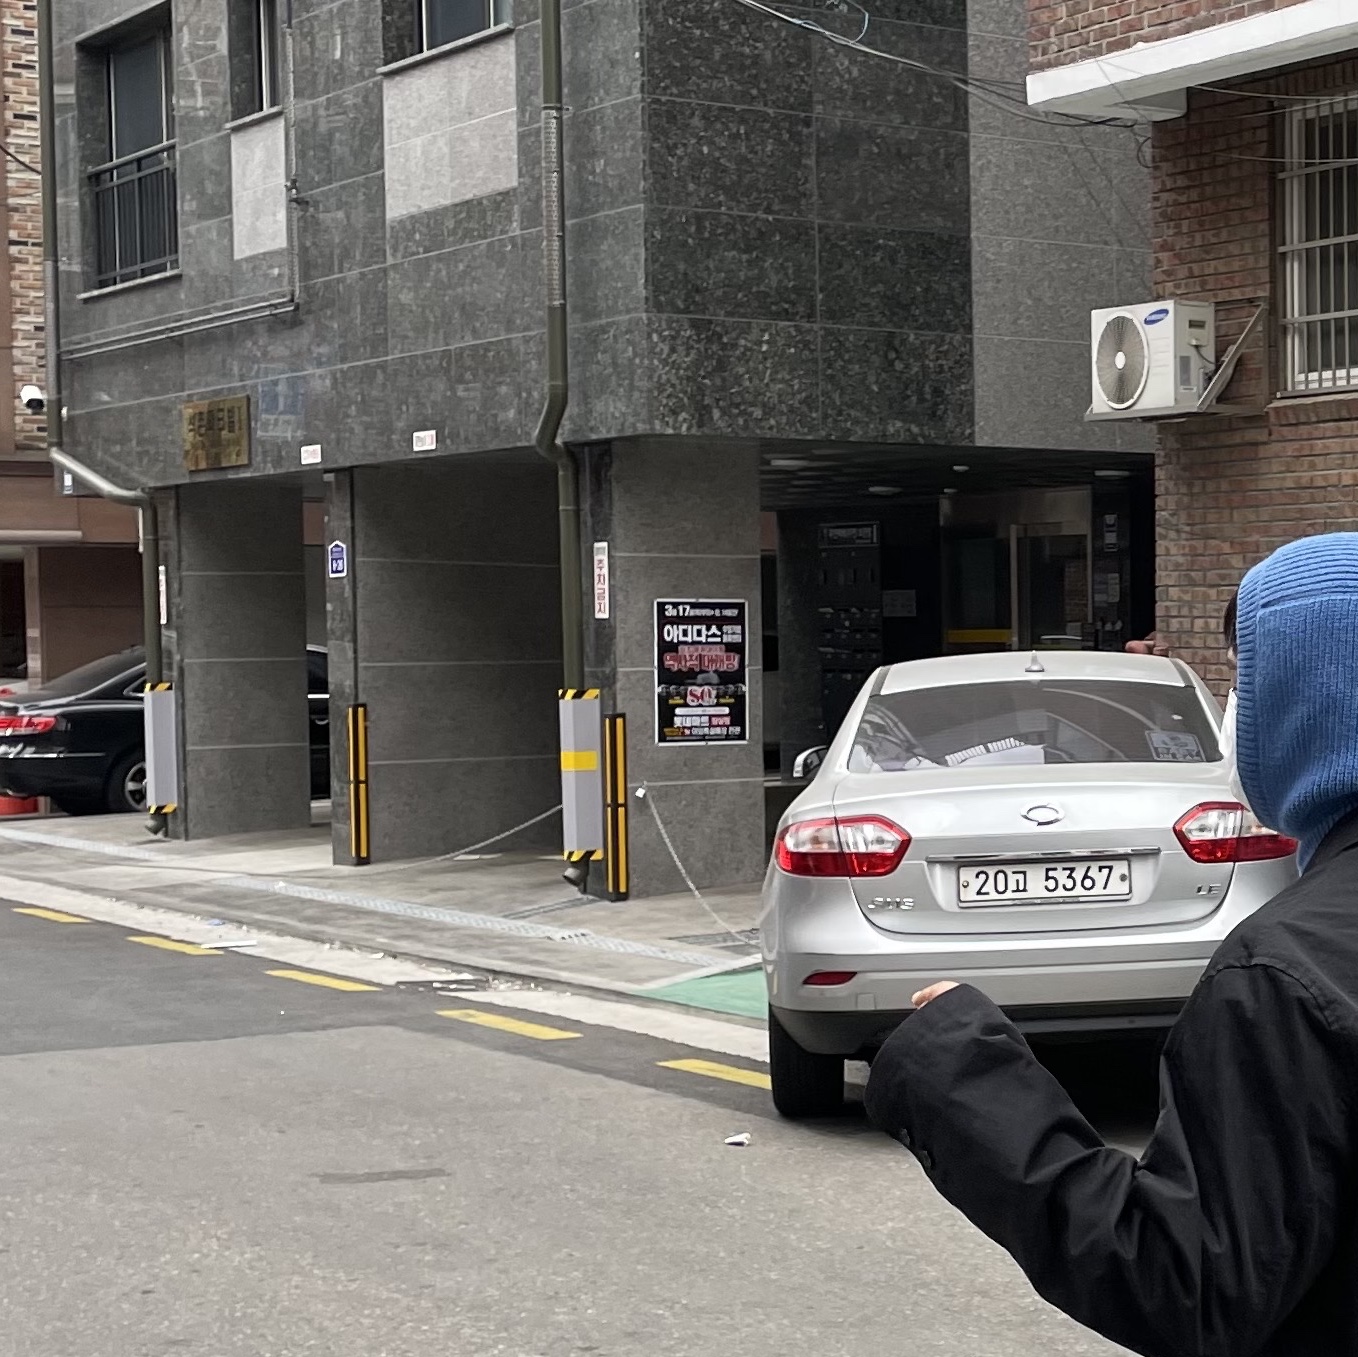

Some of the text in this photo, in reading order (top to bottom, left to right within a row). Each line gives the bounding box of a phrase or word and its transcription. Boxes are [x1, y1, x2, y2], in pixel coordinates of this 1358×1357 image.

[596, 558, 607, 615] 주차금지
[663, 623, 722, 643] 아디다스
[974, 864, 1115, 897] 20고 5367
